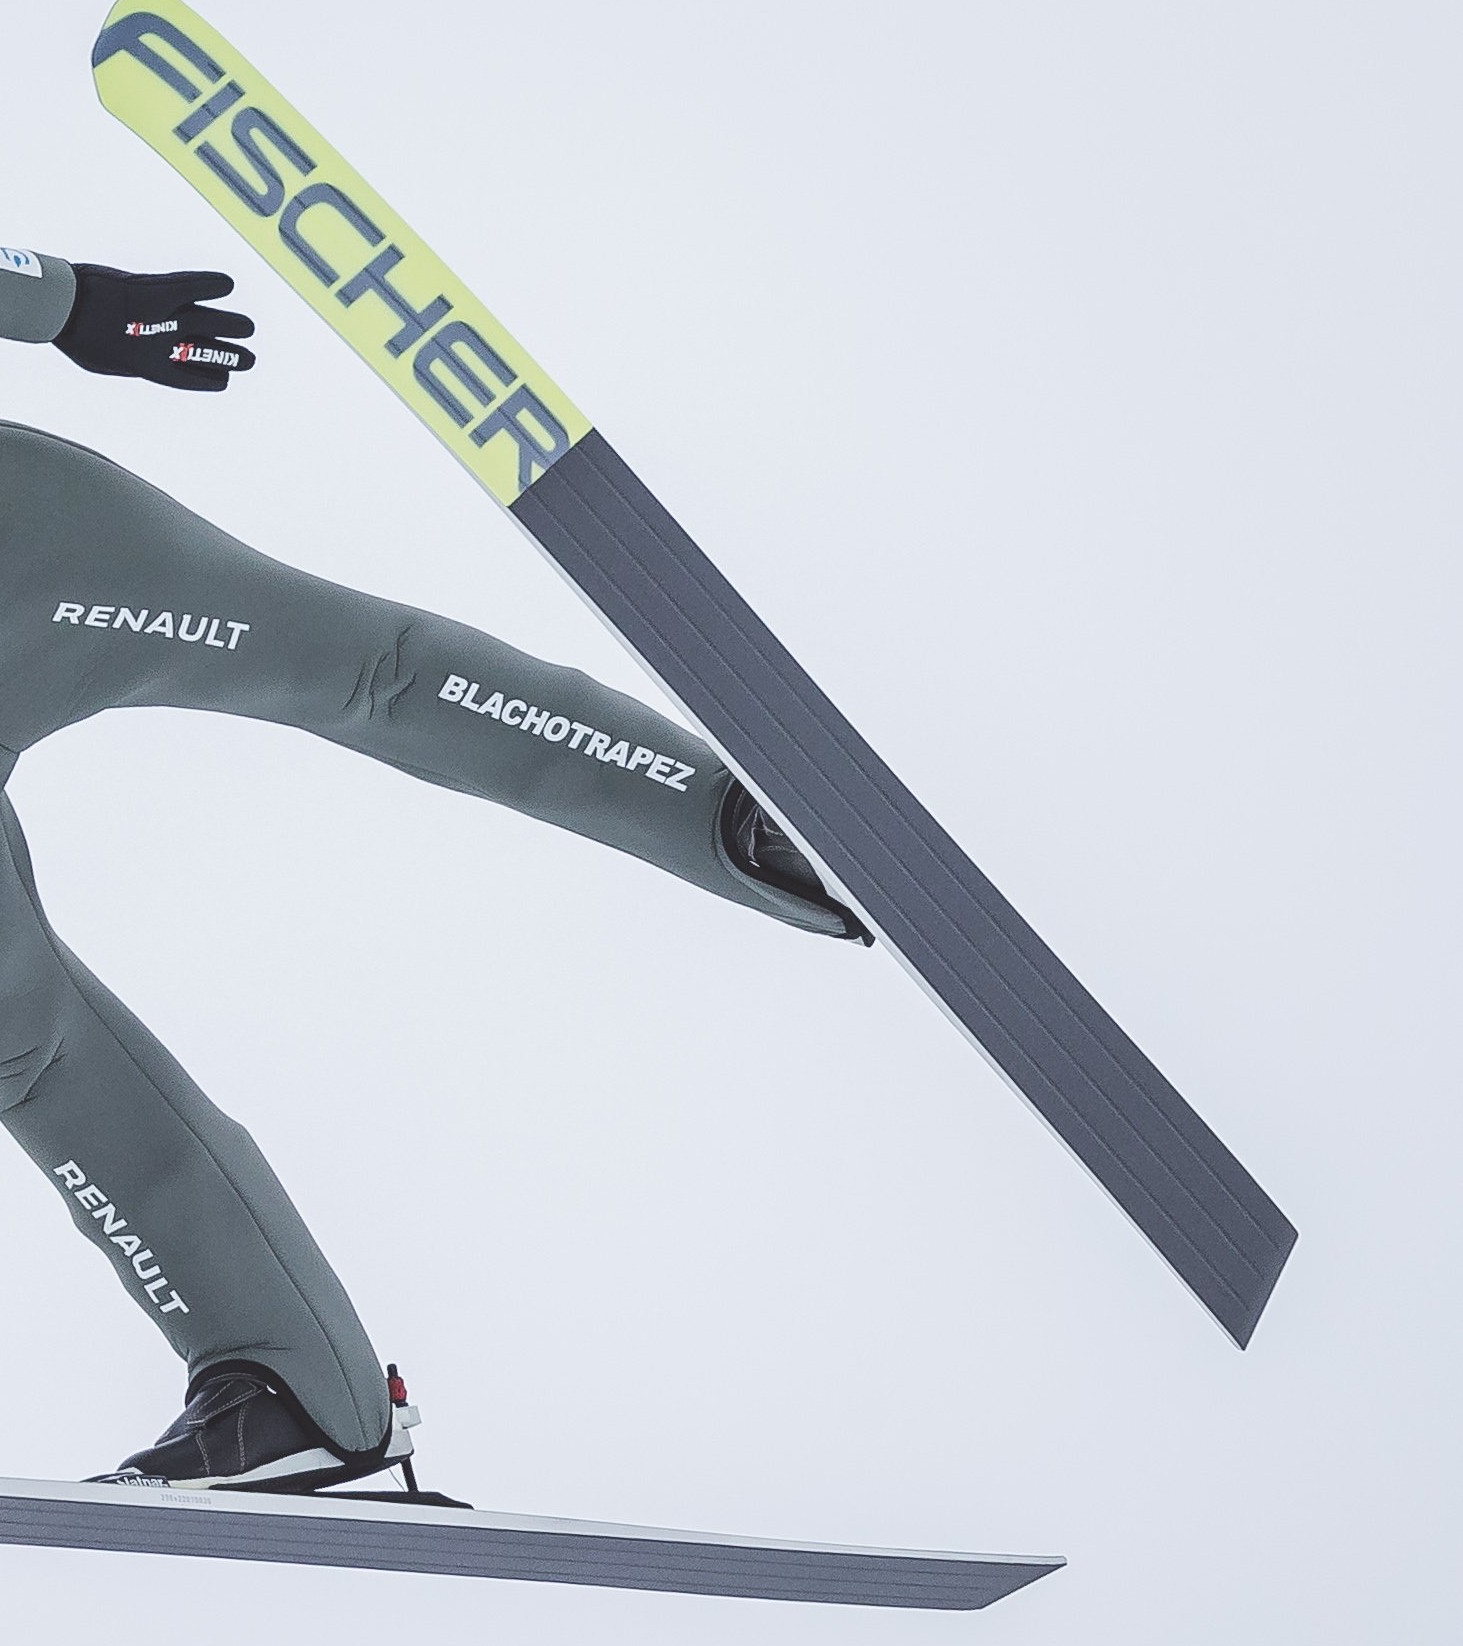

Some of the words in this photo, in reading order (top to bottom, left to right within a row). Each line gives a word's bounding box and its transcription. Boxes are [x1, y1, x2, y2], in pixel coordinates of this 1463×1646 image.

[92, 11, 571, 492] FISCHER
[52, 602, 250, 650] RENAULT
[438, 674, 695, 792] BLACHOTRAPEZ
[53, 1159, 190, 1314] RENAULT
